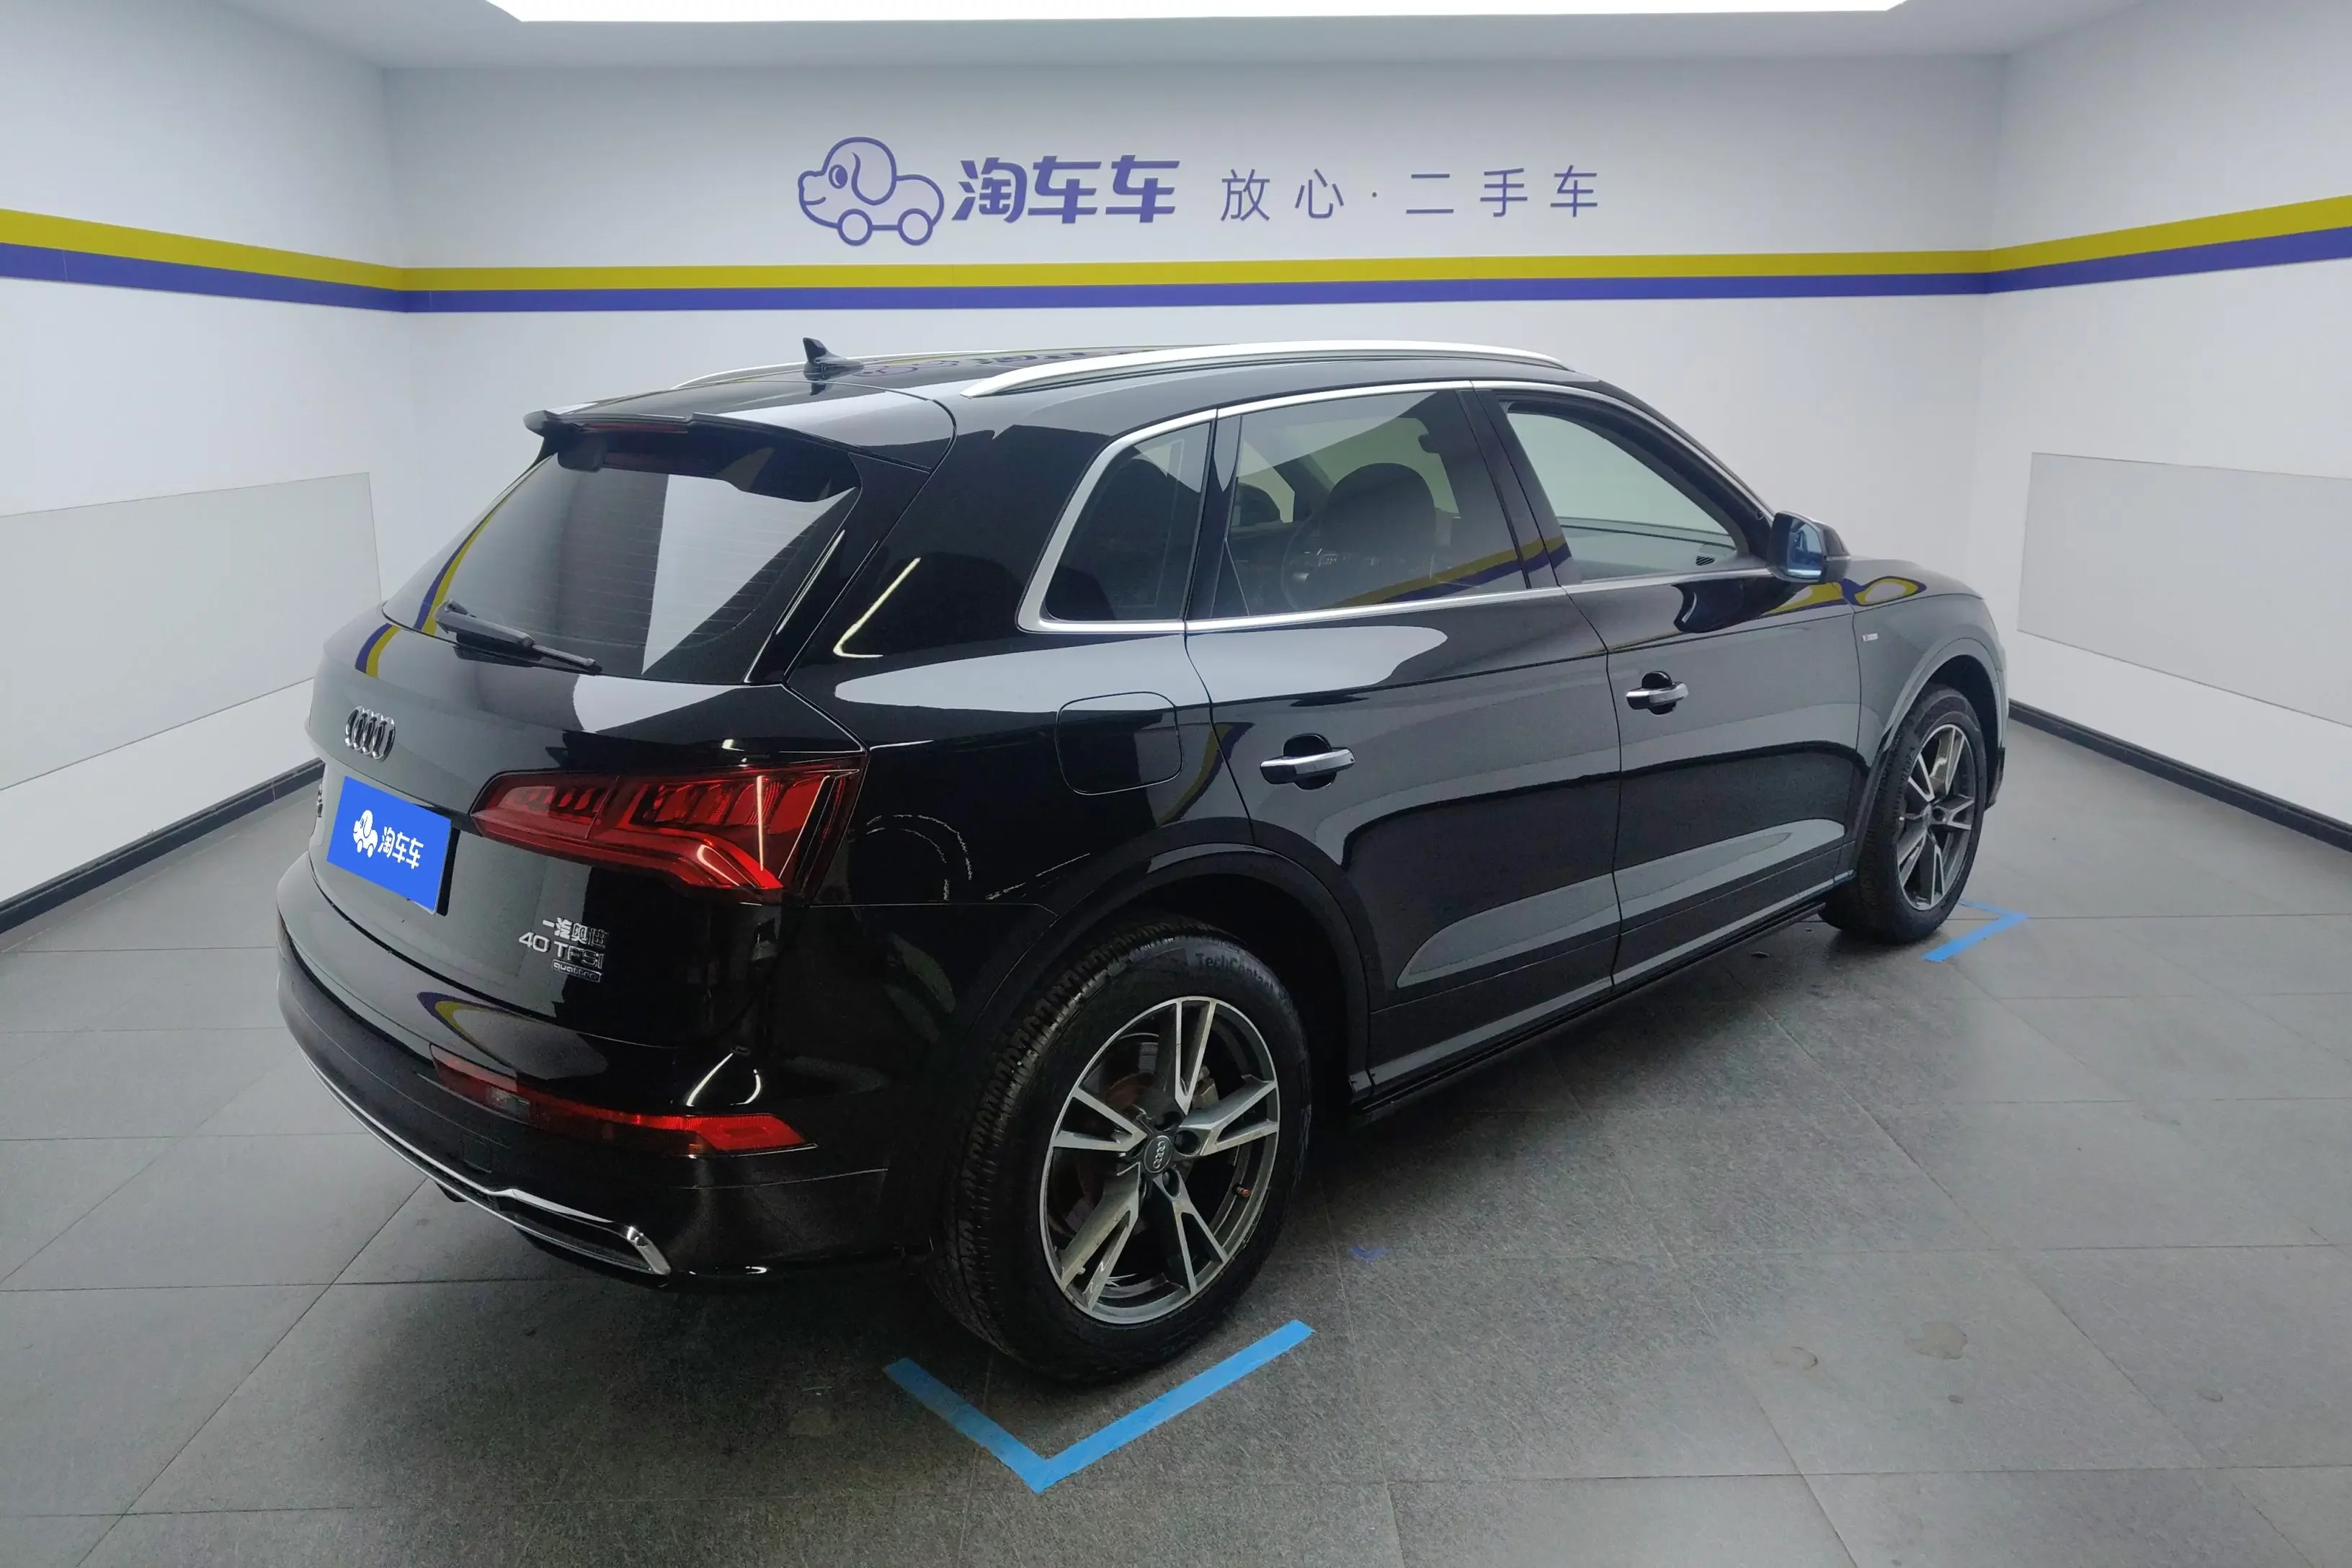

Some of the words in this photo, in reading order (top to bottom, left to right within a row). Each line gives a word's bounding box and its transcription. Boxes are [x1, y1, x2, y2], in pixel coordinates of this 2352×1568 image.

[951, 154, 1180, 225] 淘车车
[518, 932, 551, 953] 40
[553, 940, 605, 970] TFSI
[542, 917, 609, 949] 一汽奥迪
